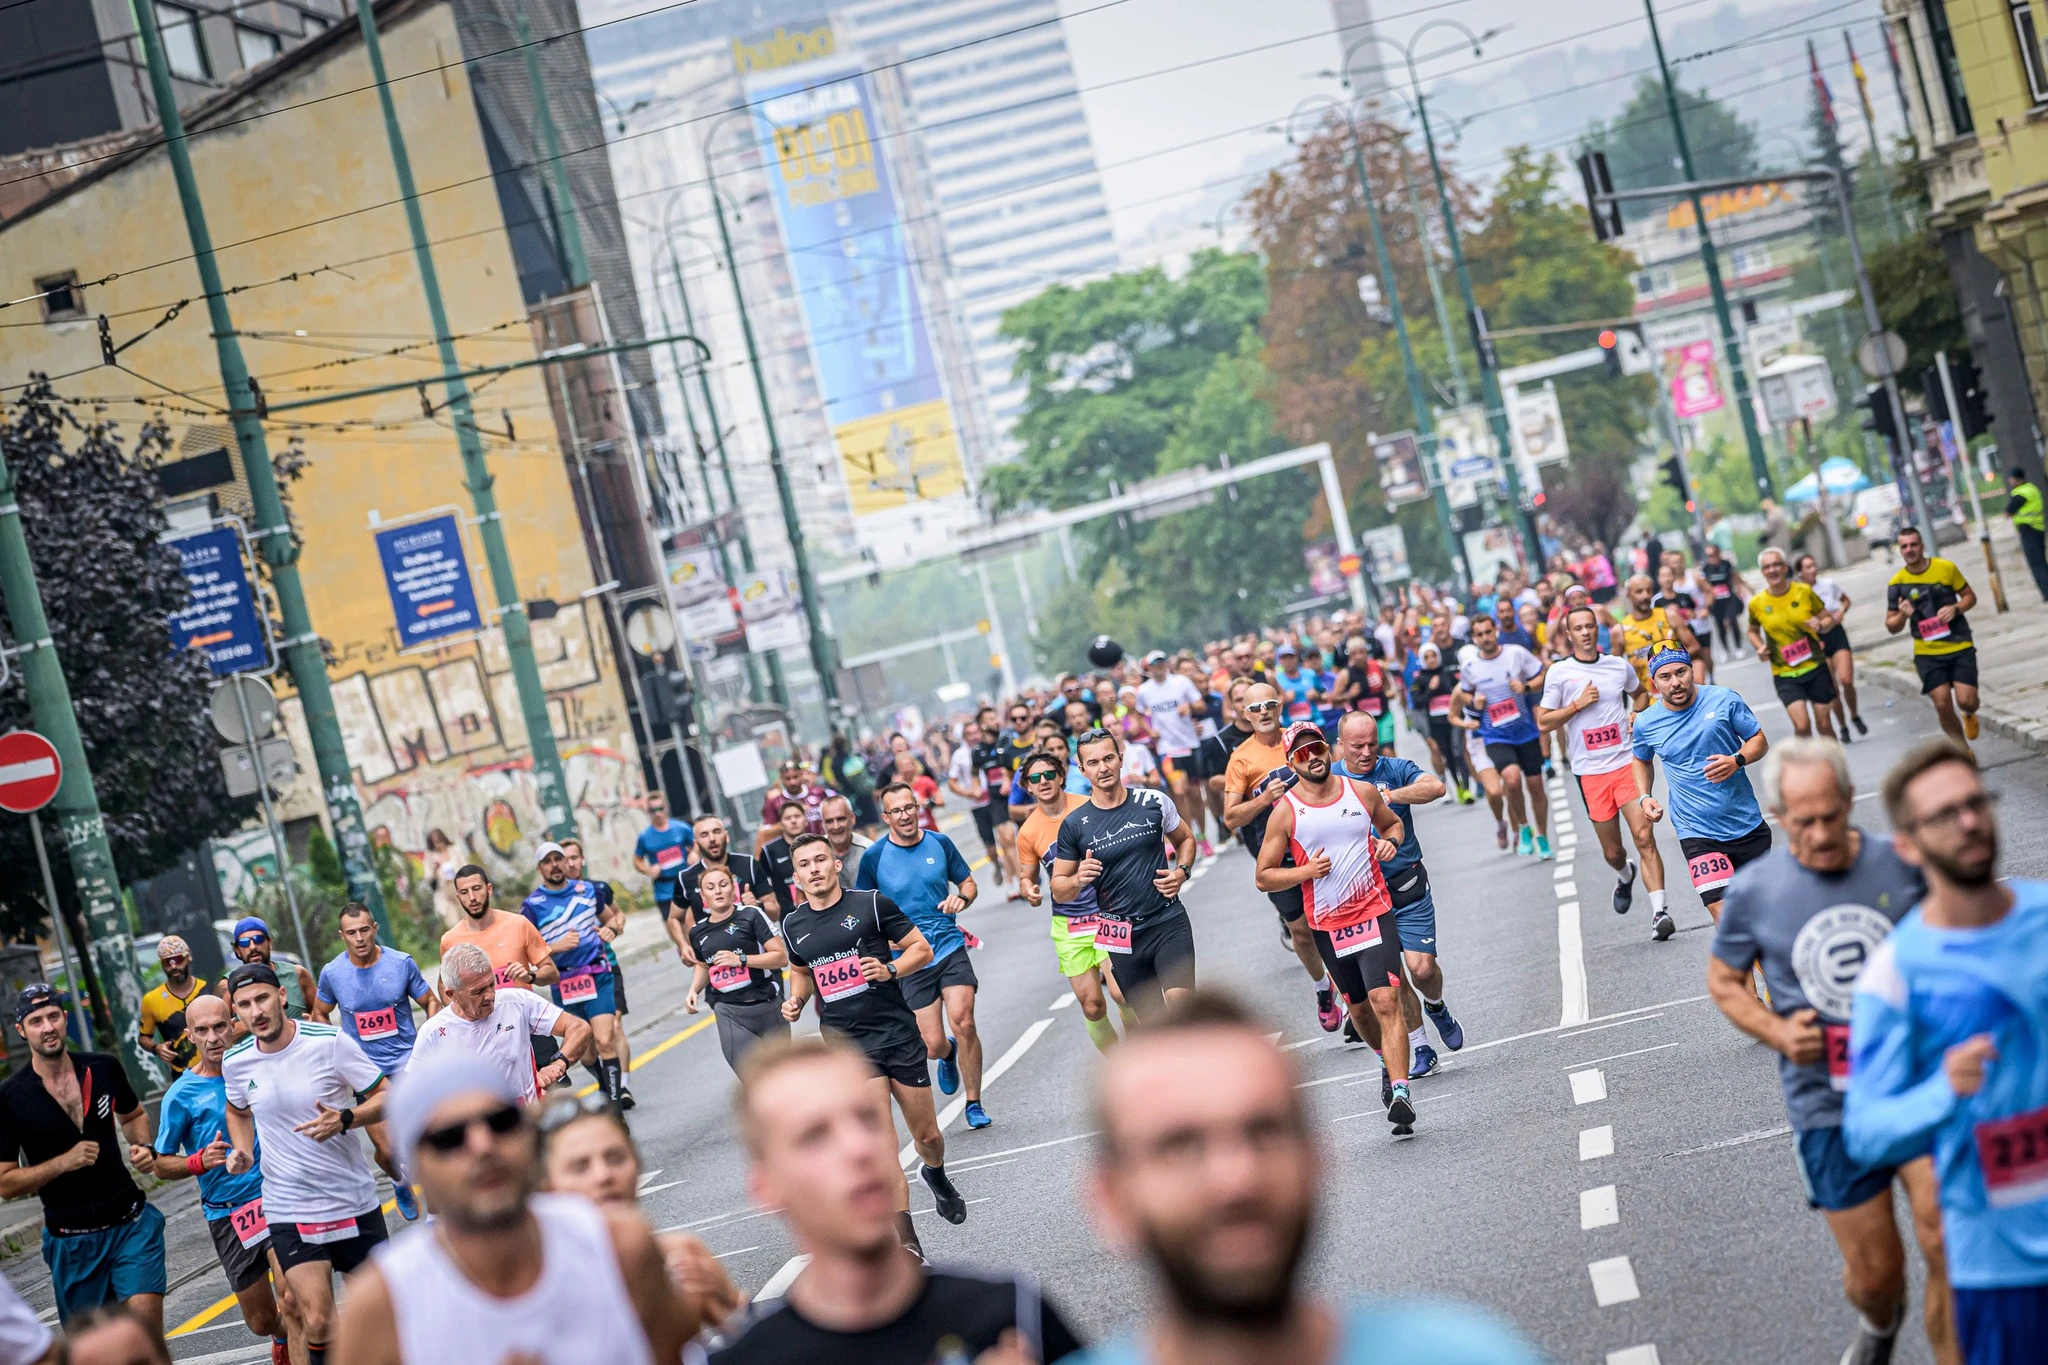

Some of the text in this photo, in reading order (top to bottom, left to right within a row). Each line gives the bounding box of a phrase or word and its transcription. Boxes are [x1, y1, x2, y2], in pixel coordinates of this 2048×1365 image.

[732, 27, 835, 74] haloo
[1587, 728, 1618, 744] 2332
[1692, 857, 1729, 879] 2838
[1097, 922, 1127, 940] 2030
[1333, 919, 1373, 942] 2837
[834, 947, 859, 961] Bank
[819, 963, 859, 988] 2666
[360, 1013, 392, 1029] 2691
